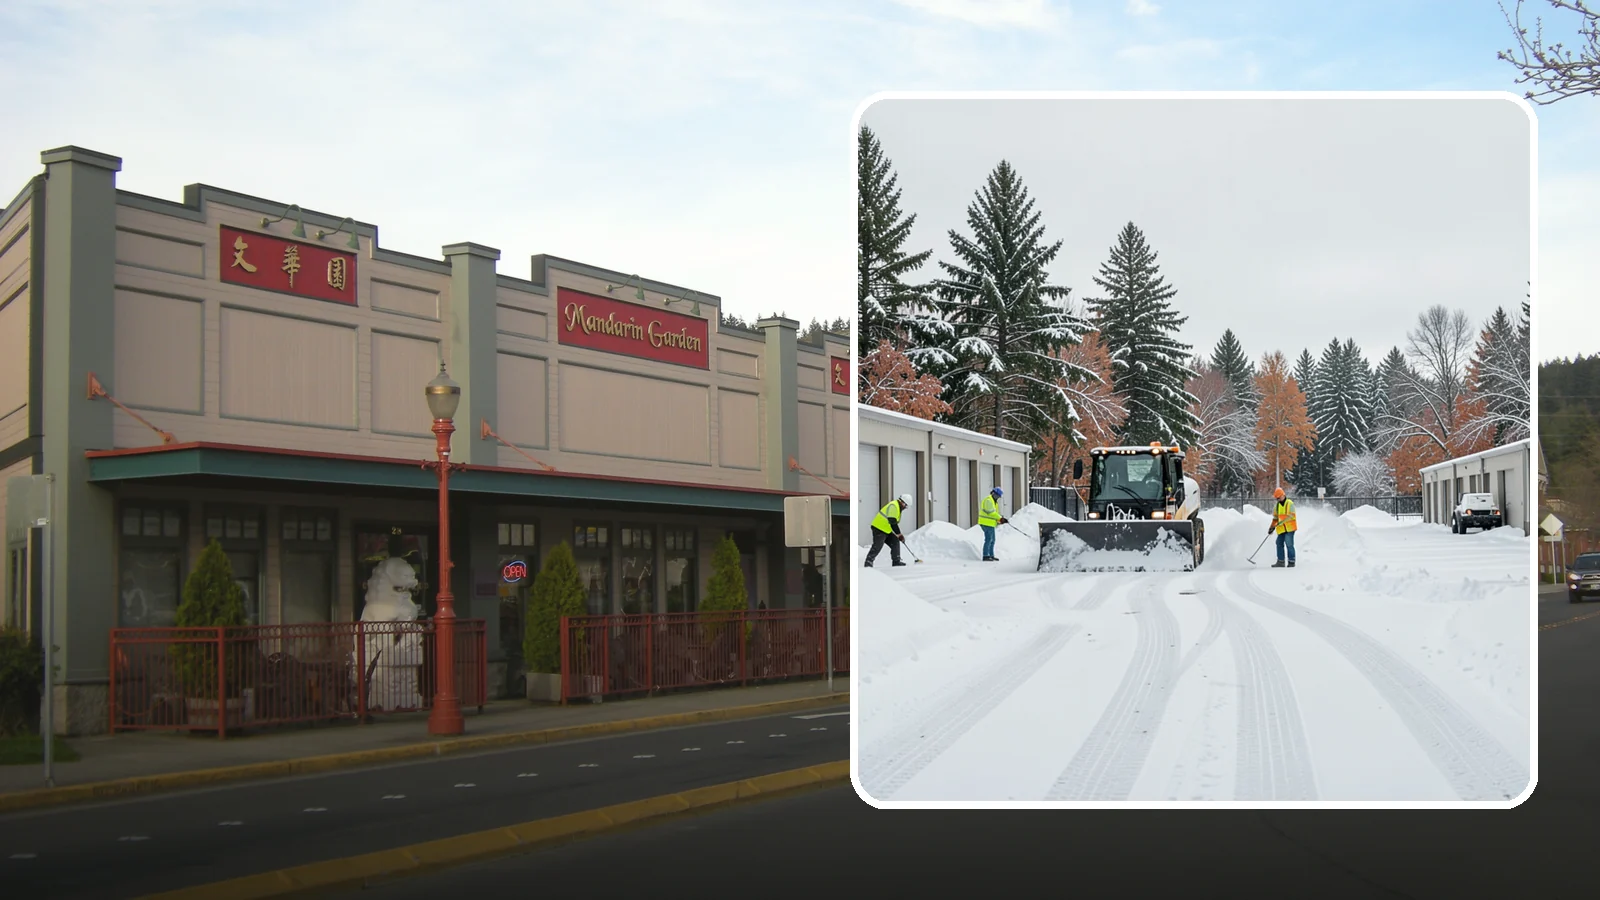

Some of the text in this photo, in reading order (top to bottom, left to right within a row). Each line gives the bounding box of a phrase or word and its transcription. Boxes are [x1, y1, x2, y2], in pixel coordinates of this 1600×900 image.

[564, 302, 702, 352] Mandarin Garden
[503, 565, 527, 578] OPEN
